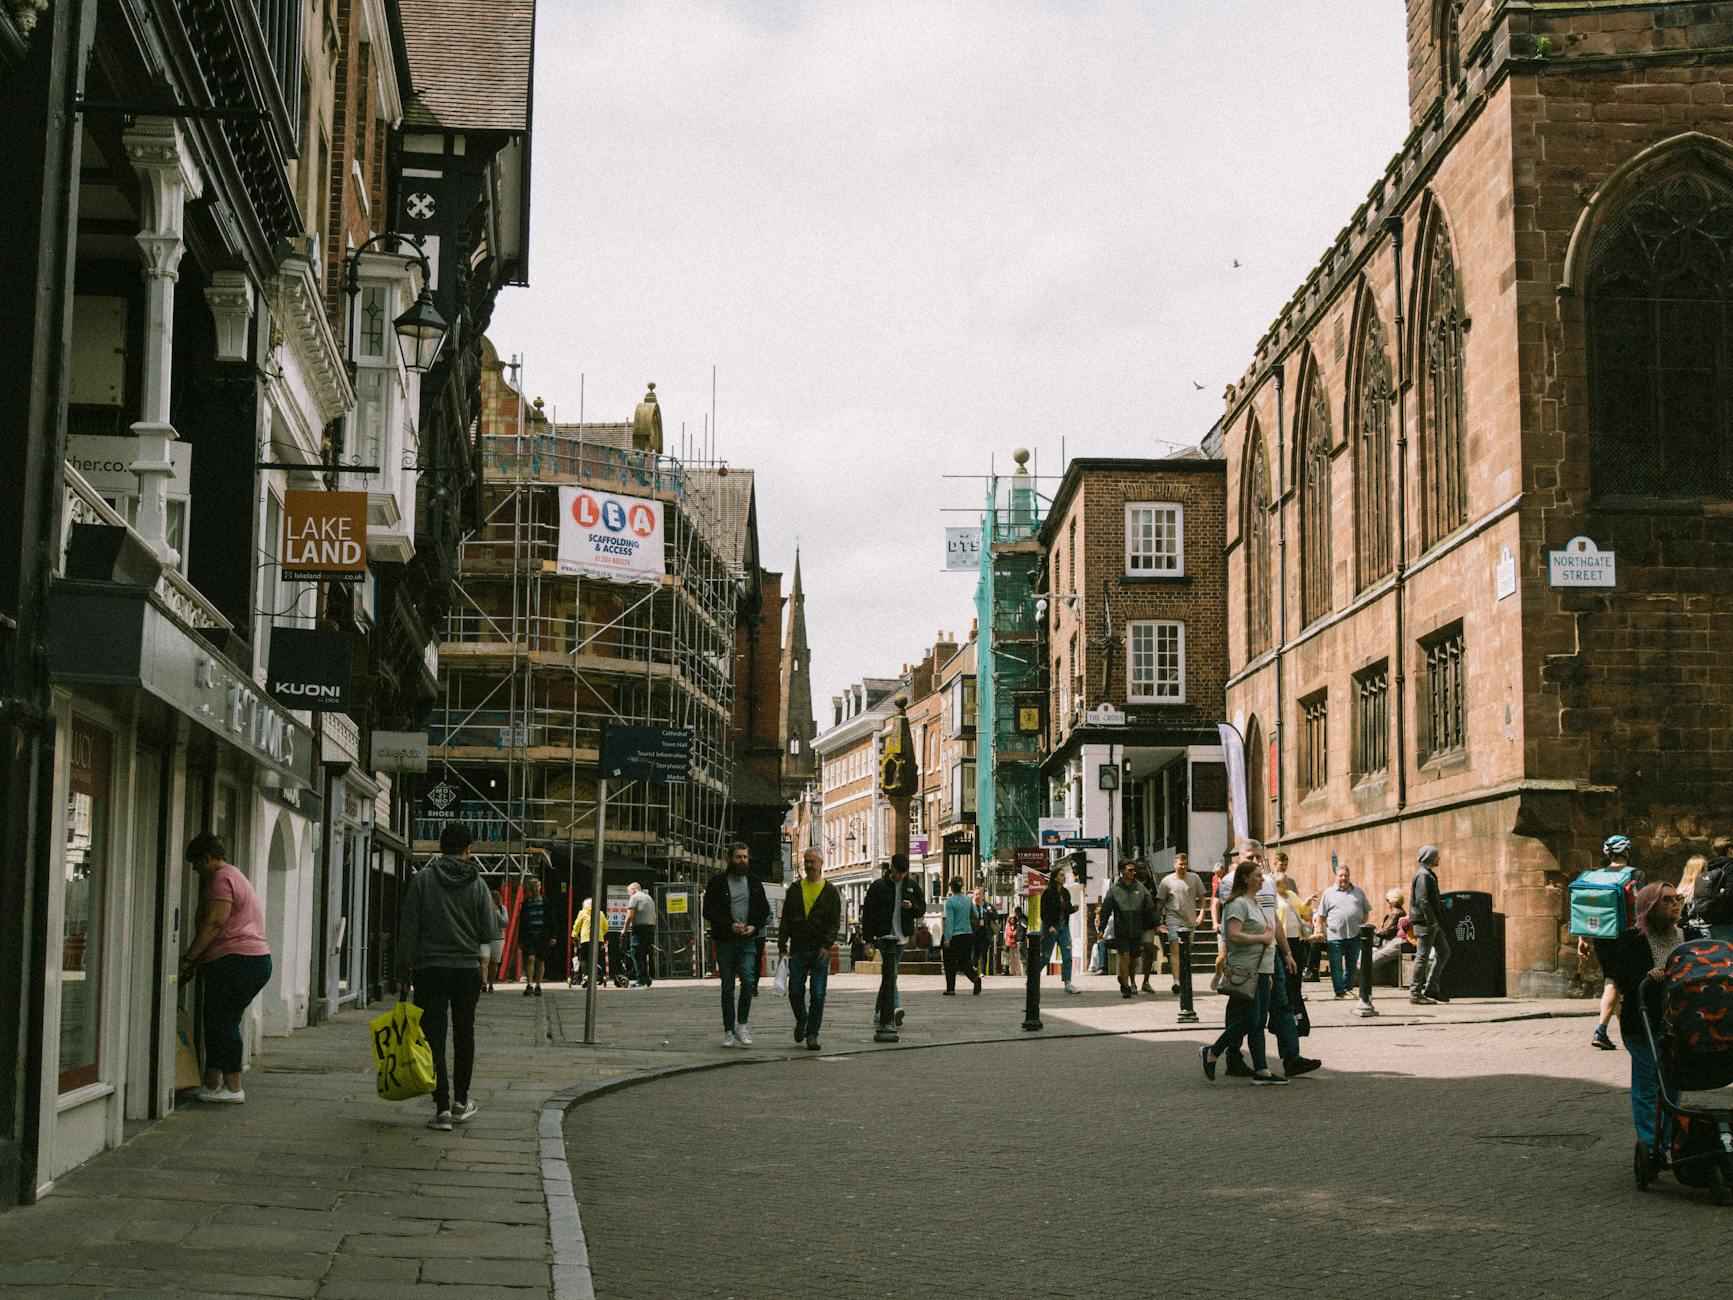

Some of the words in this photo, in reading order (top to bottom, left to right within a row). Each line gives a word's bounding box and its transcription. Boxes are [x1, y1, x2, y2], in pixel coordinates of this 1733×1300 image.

[579, 497, 652, 533] LEA
[286, 515, 353, 540] LAKE
[588, 533, 640, 549] SCAFFOLDING
[286, 540, 362, 565] LAND
[594, 543, 602, 552] &
[603, 544, 633, 556] ACCESS
[1552, 556, 1614, 568] NORTHGATE
[1561, 570, 1604, 581] STREET
[274, 681, 341, 698] KUONI
